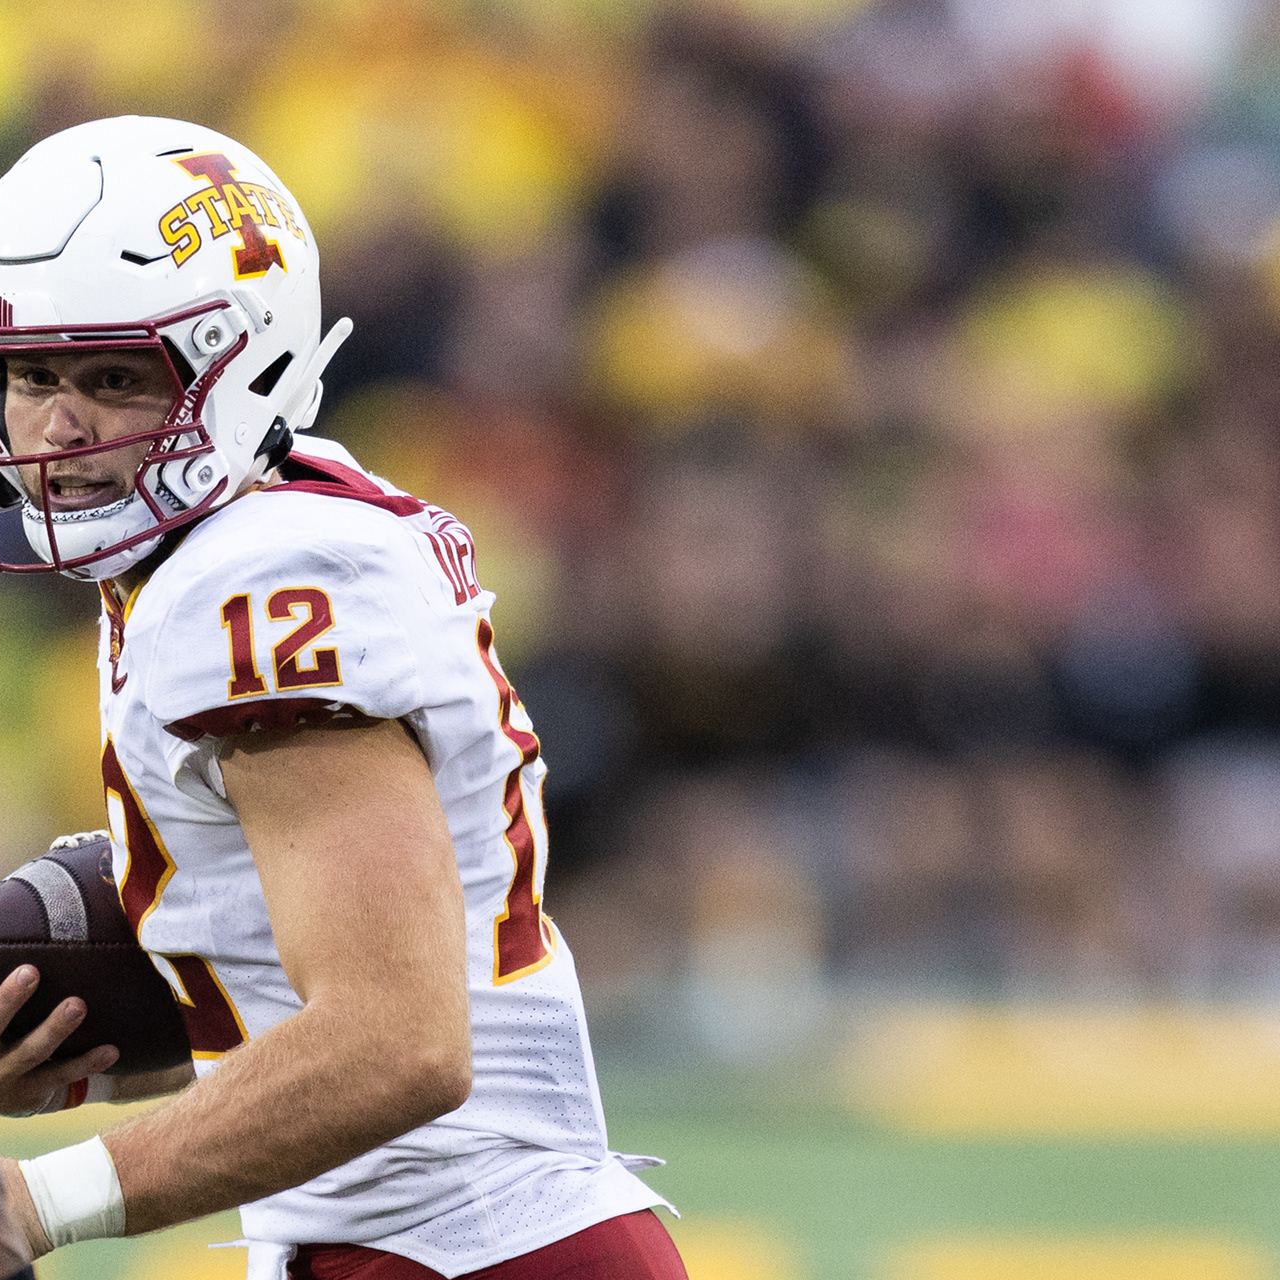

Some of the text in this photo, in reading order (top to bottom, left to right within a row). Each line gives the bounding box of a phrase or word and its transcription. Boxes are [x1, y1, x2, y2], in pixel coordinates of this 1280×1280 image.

[158, 180, 308, 269] STATE
[220, 586, 343, 701] 12
[475, 611, 557, 987] 1
